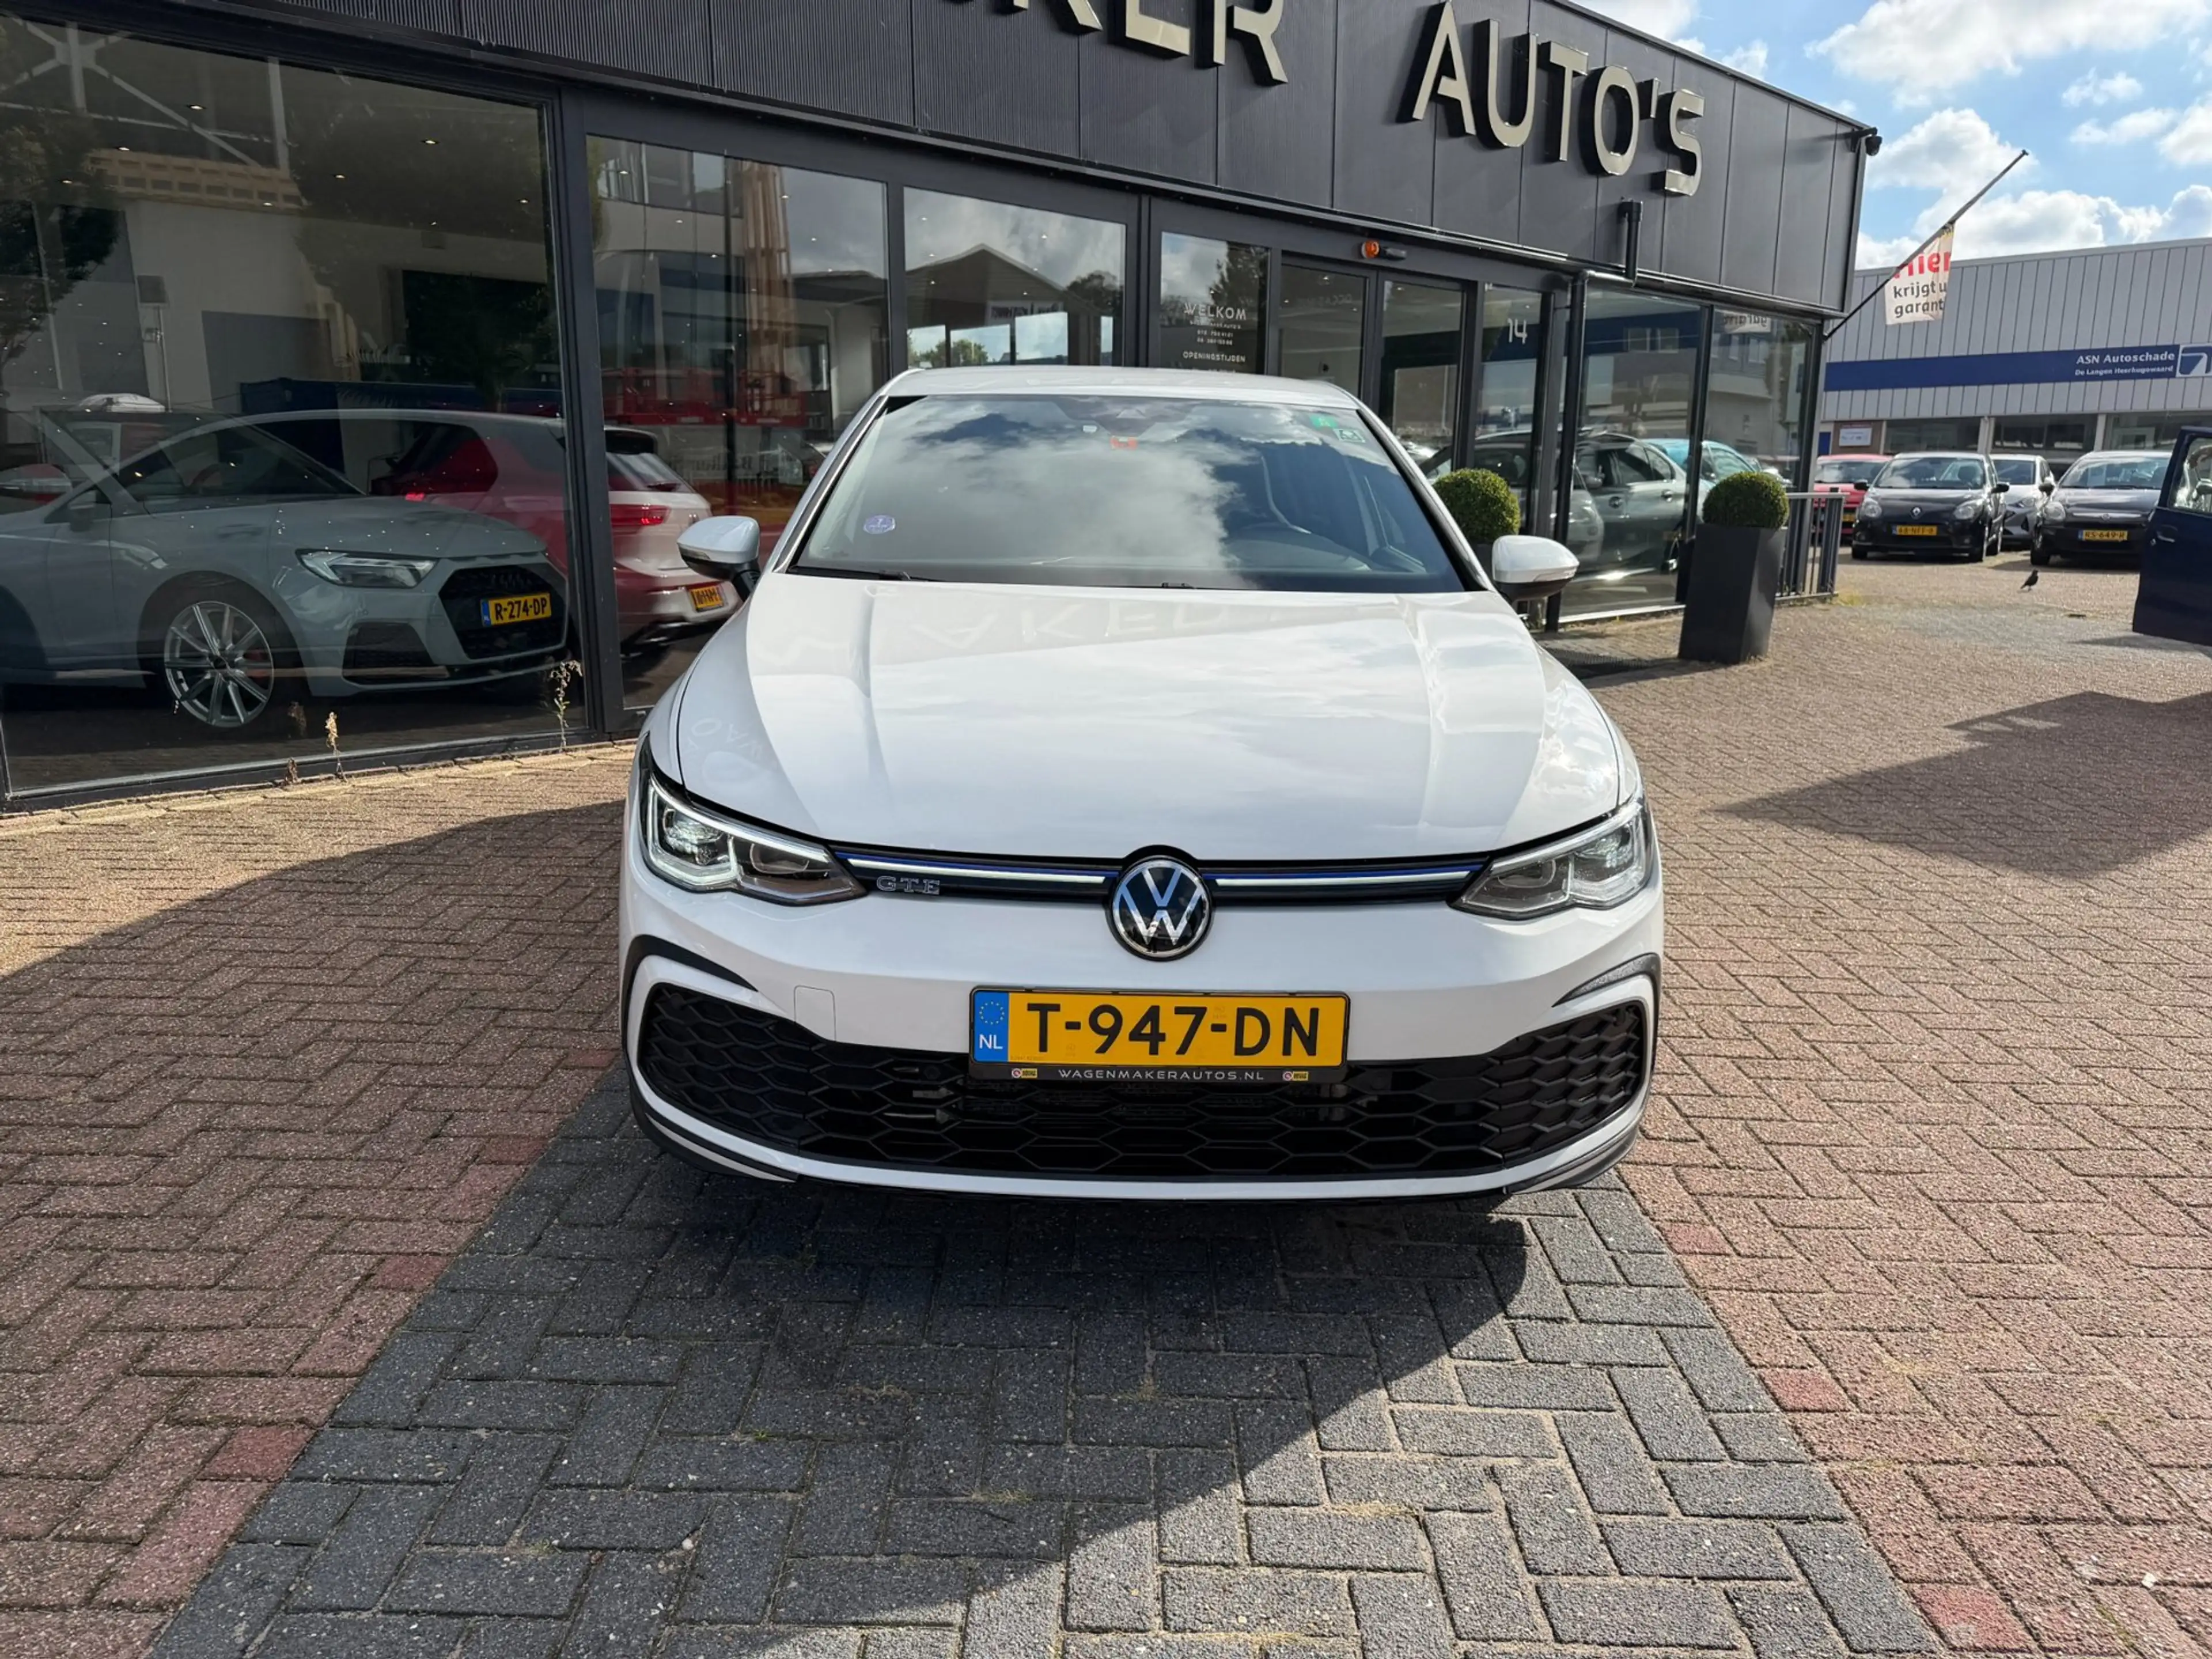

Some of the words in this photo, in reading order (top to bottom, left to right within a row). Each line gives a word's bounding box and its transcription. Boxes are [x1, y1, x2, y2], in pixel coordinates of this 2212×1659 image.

[1411, 2, 1705, 197] AUTO'S
[1893, 281, 1936, 298] krijgt
[1940, 282, 1947, 293] u
[1183, 302, 1247, 320] WELKOM
[1507, 317, 1528, 344] 14
[1183, 351, 1245, 363] OPENINGSTIJDEN
[2076, 354, 2100, 365] ASN
[2103, 351, 2175, 363] Autoschade
[494, 598, 547, 622] R-274-DP
[876, 875, 940, 895] GTE
[979, 1034, 1003, 1050] NL
[1027, 1002, 1319, 1056] T-947-DN
[1058, 1069, 1264, 1081] WAGENMAKERAUTOS.NL
